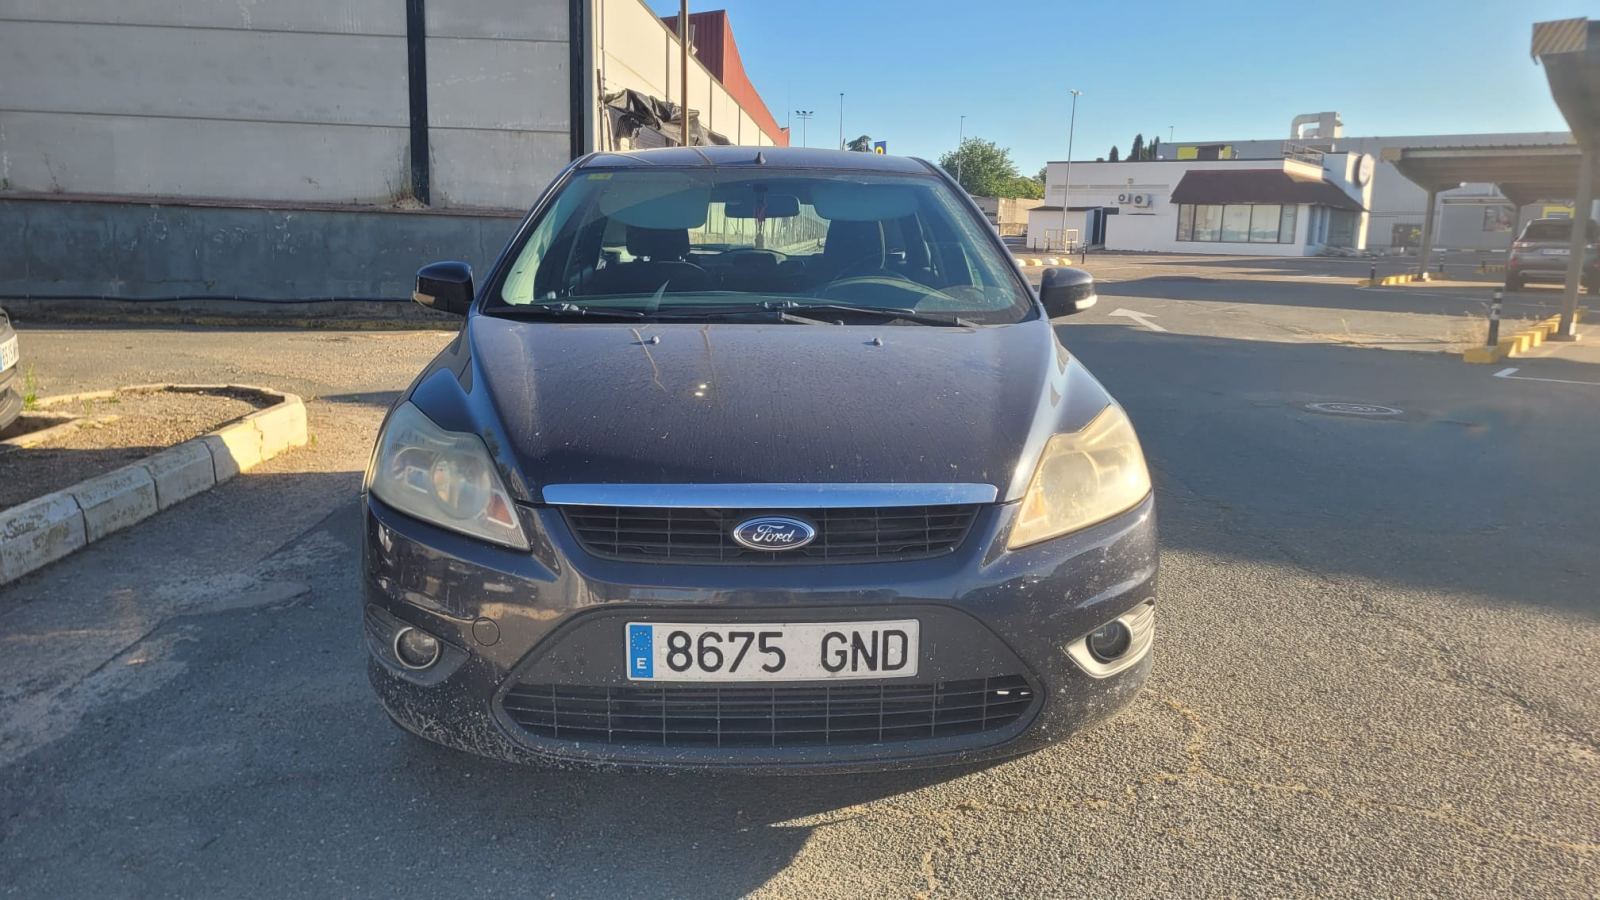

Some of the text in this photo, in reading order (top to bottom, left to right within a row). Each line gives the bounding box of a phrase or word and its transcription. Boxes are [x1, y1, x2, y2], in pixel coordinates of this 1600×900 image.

[752, 524, 796, 543] Ford
[666, 629, 909, 673] 8675 GND
[636, 657, 647, 669] E
